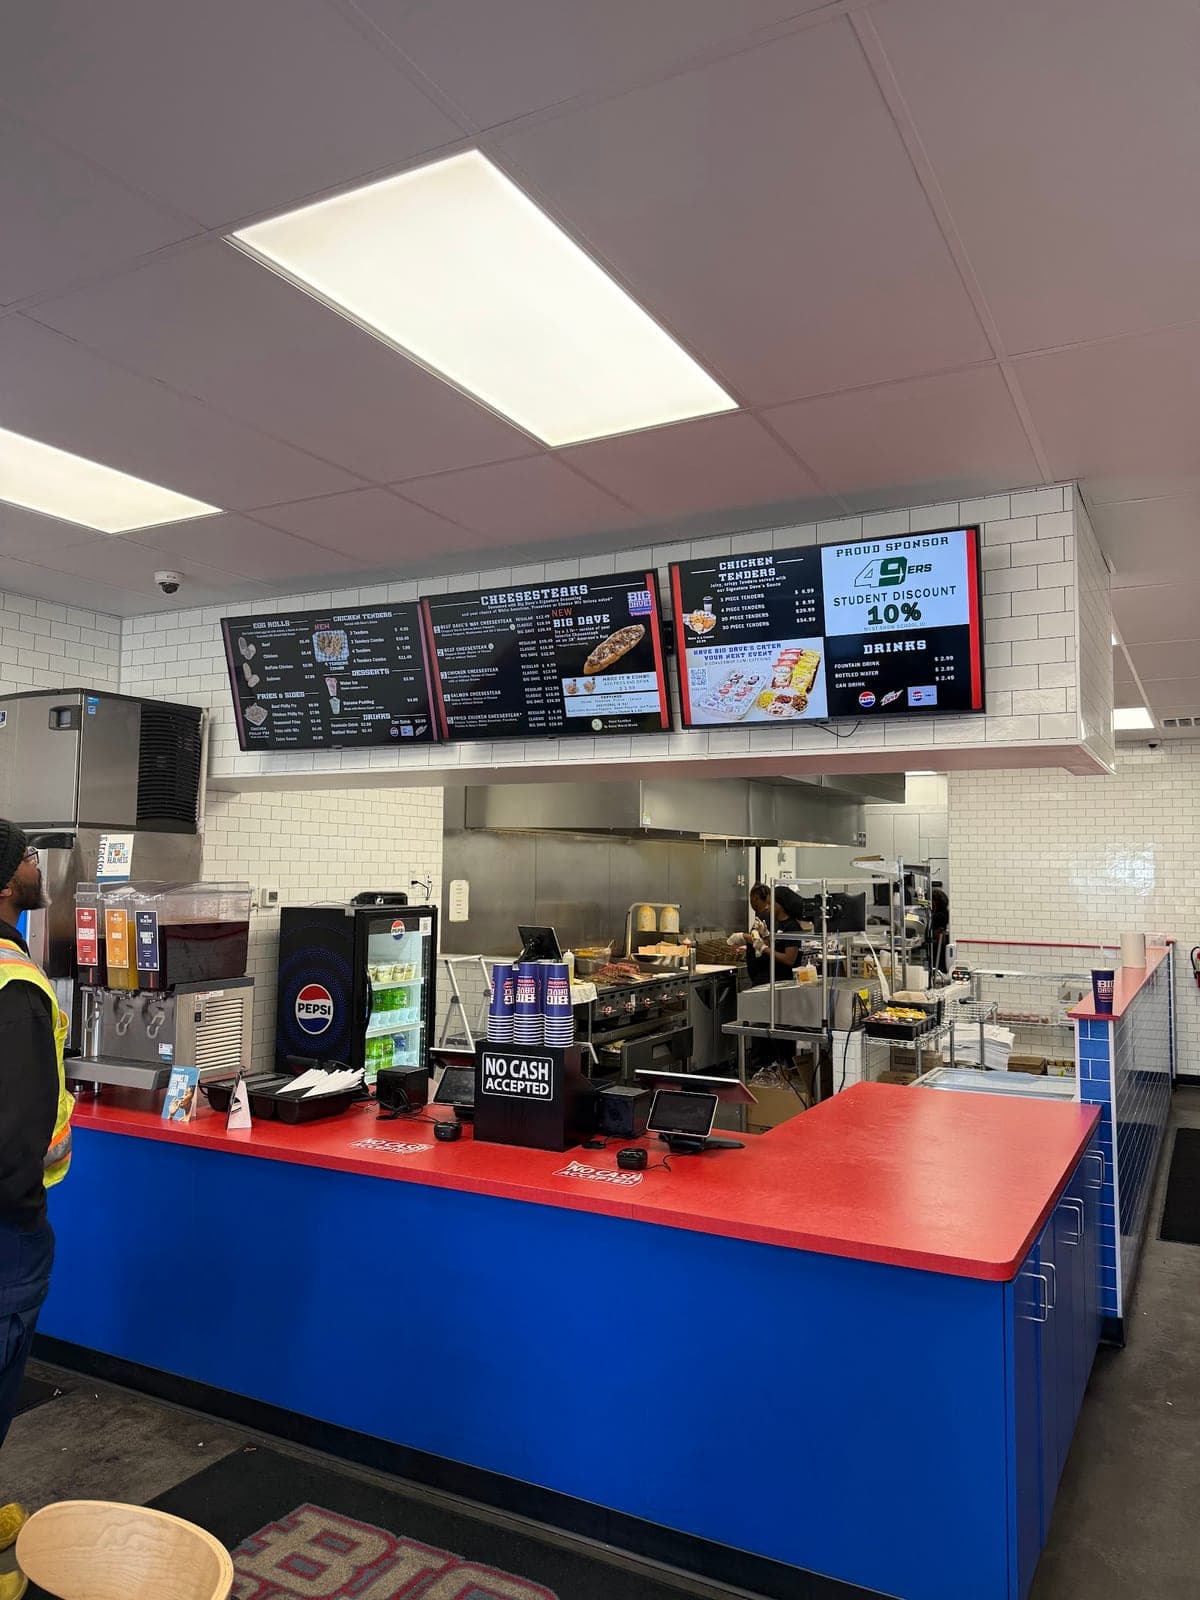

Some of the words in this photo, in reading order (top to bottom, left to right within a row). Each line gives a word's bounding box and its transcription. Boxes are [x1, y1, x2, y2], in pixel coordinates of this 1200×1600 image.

[836, 545, 880, 558] PROUD
[886, 536, 948, 552] SPONSOR
[719, 557, 773, 570] CHICKEN
[718, 568, 776, 581] TENDERS
[480, 584, 588, 606] CHEESESTEAKS
[627, 591, 651, 601] BIG
[833, 592, 888, 607] STUDENT
[893, 586, 956, 601] DISCOUNT
[552, 608, 572, 617] NEW
[868, 602, 922, 626] 10%
[553, 618, 573, 628] BIG
[578, 614, 610, 625] DAVE
[863, 640, 926, 654] DRINKS
[547, 996, 568, 1005] BIG
[298, 1003, 331, 1016] PEPSI
[486, 1057, 507, 1076] NO
[510, 1060, 549, 1080] CASH
[486, 1078, 549, 1095] ACCEPTED
[560, 1170, 634, 1185] ACCEPTED
[566, 1165, 596, 1174] NO
[596, 1170, 641, 1181] CASH
